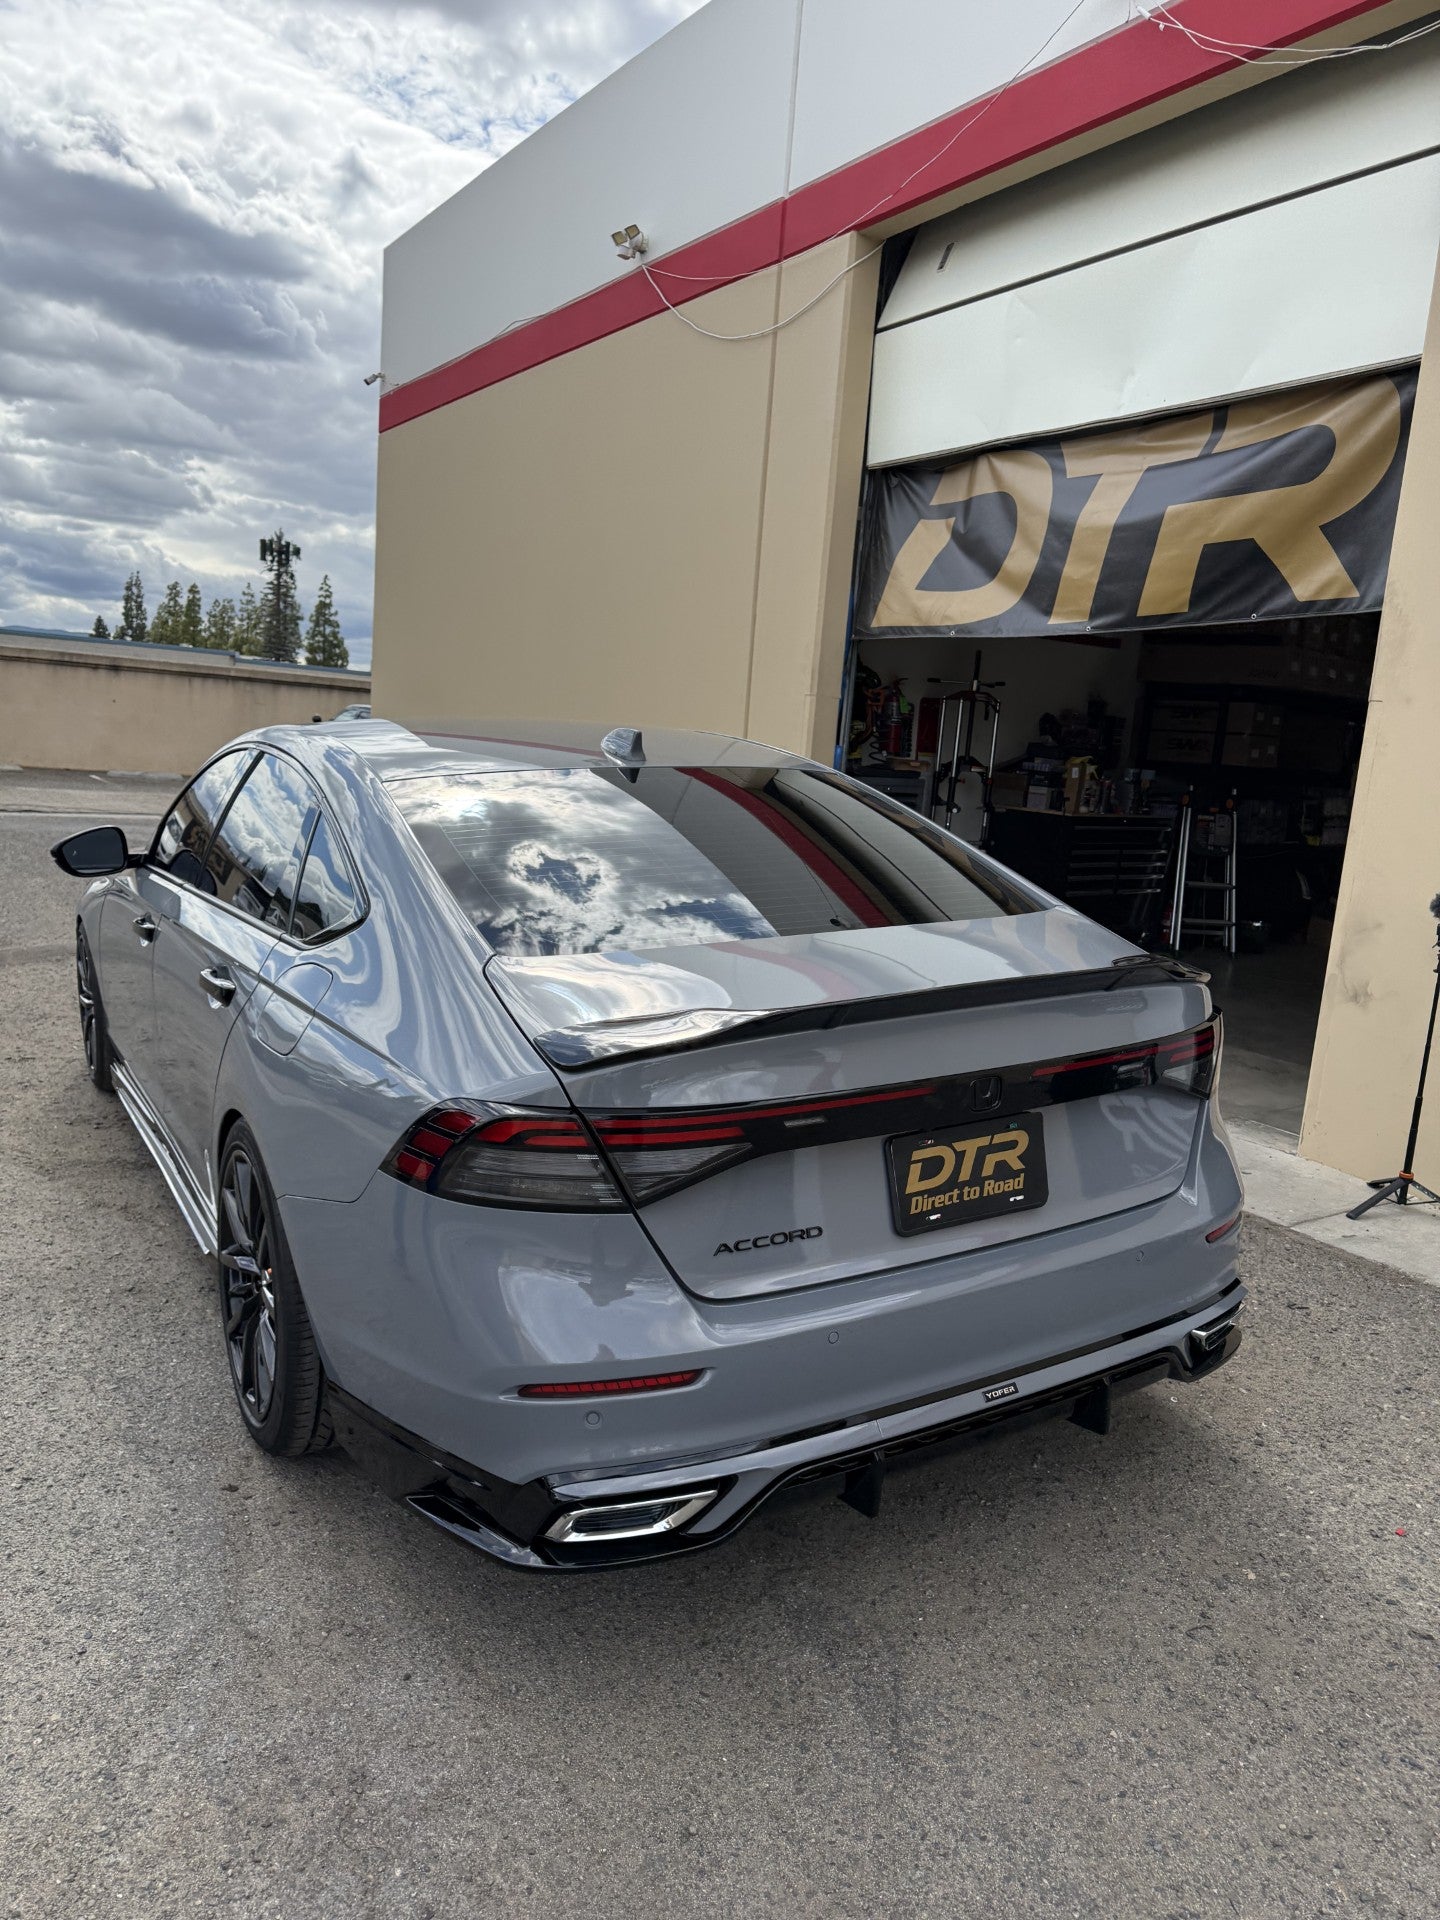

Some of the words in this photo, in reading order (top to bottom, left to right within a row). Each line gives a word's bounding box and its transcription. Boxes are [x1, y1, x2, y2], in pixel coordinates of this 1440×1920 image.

[870, 375, 1401, 628] DTR
[905, 1129, 1030, 1195] DTR
[910, 1188, 960, 1215] Direct
[963, 1185, 980, 1201] to
[983, 1173, 1025, 1197] Road
[713, 1225, 824, 1257] ACCORD
[985, 1385, 1016, 1399] YOFER
